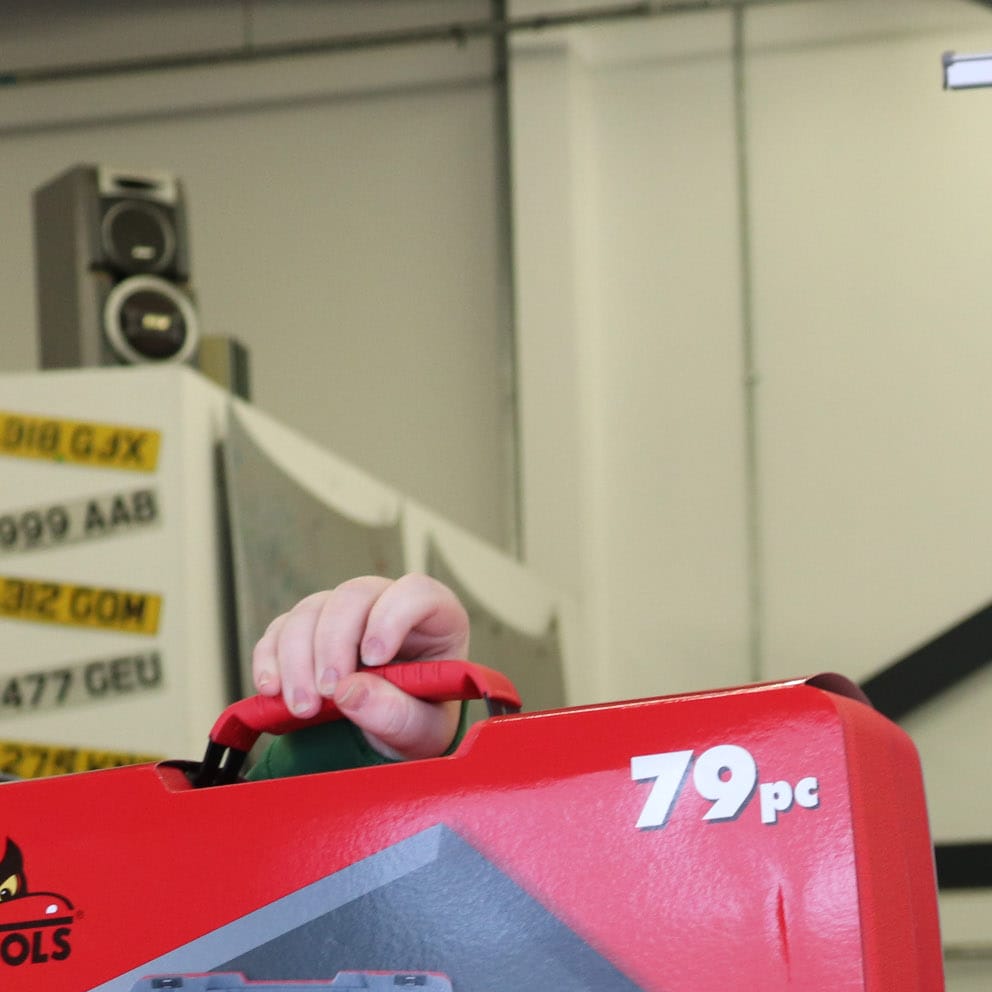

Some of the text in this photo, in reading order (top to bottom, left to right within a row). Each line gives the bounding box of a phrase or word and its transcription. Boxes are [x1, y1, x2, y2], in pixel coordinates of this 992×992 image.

[69, 424, 149, 465] GJX
[84, 488, 158, 534] AAB
[84, 651, 162, 699] GEU
